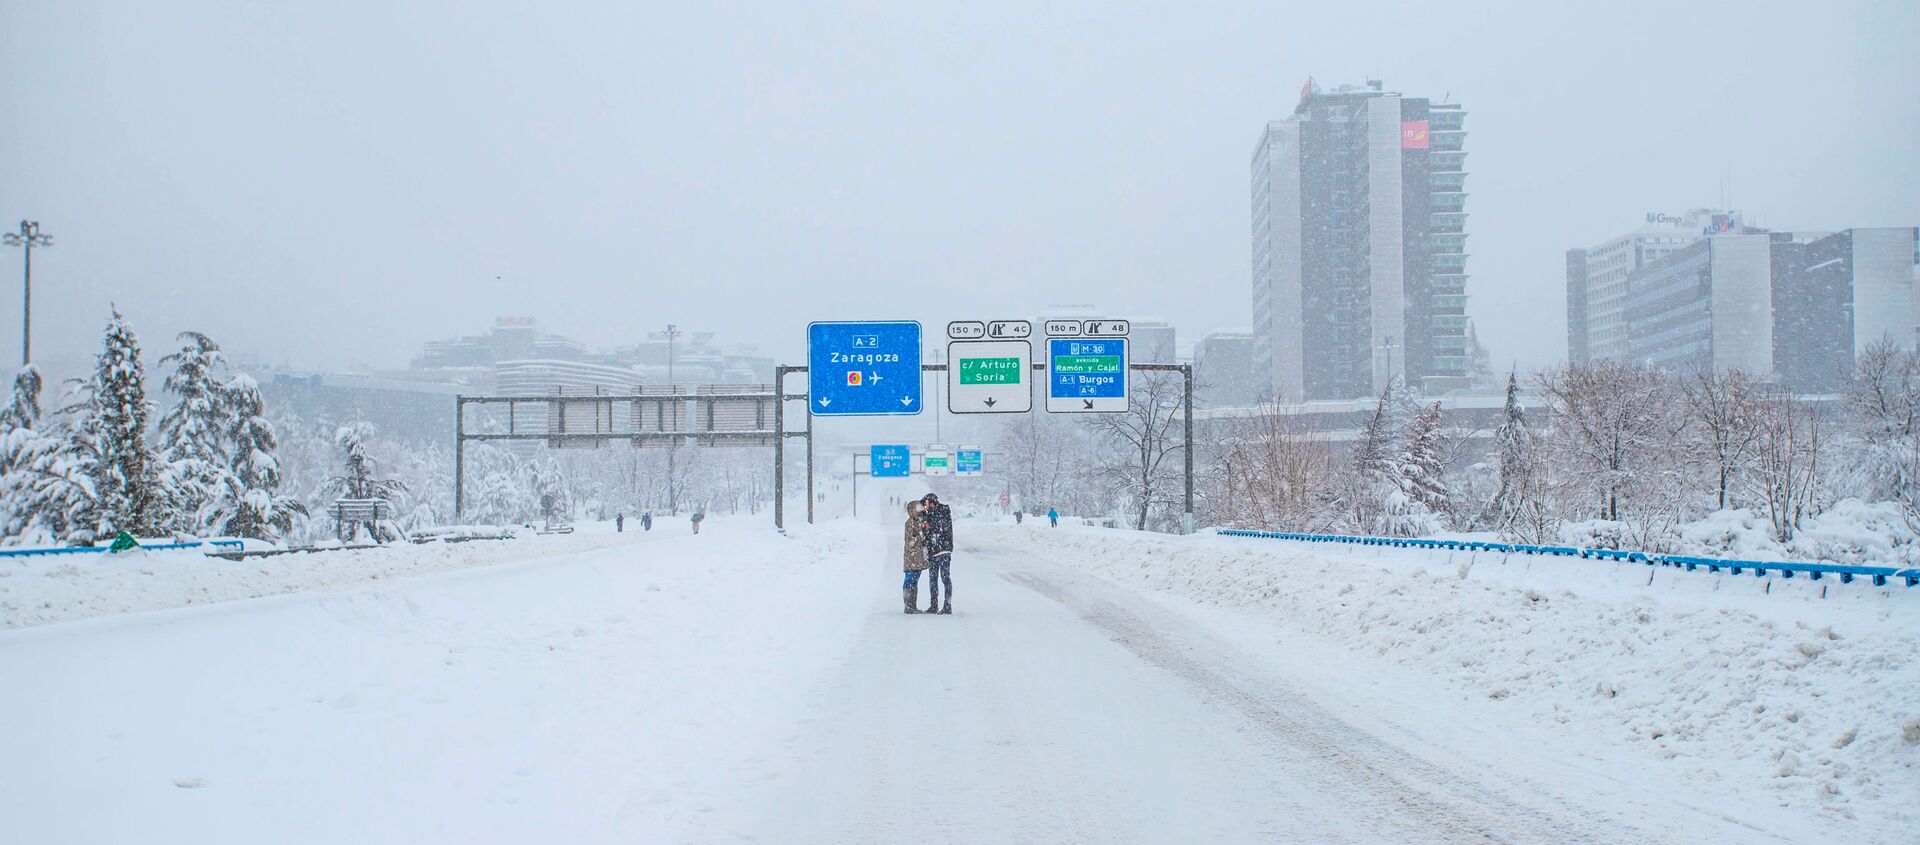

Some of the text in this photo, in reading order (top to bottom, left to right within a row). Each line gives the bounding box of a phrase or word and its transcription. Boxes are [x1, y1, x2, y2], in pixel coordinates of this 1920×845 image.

[1656, 212, 1682, 228] Gmp
[855, 337, 877, 346] A-2
[1082, 345, 1104, 353] M-30
[830, 352, 899, 365] Zaragoza
[962, 361, 1018, 370] c/ Arturo
[1056, 364, 1119, 373] Ramón y Cajal
[976, 373, 1005, 382] Soria
[1061, 375, 1114, 386] A-1 Burgos
